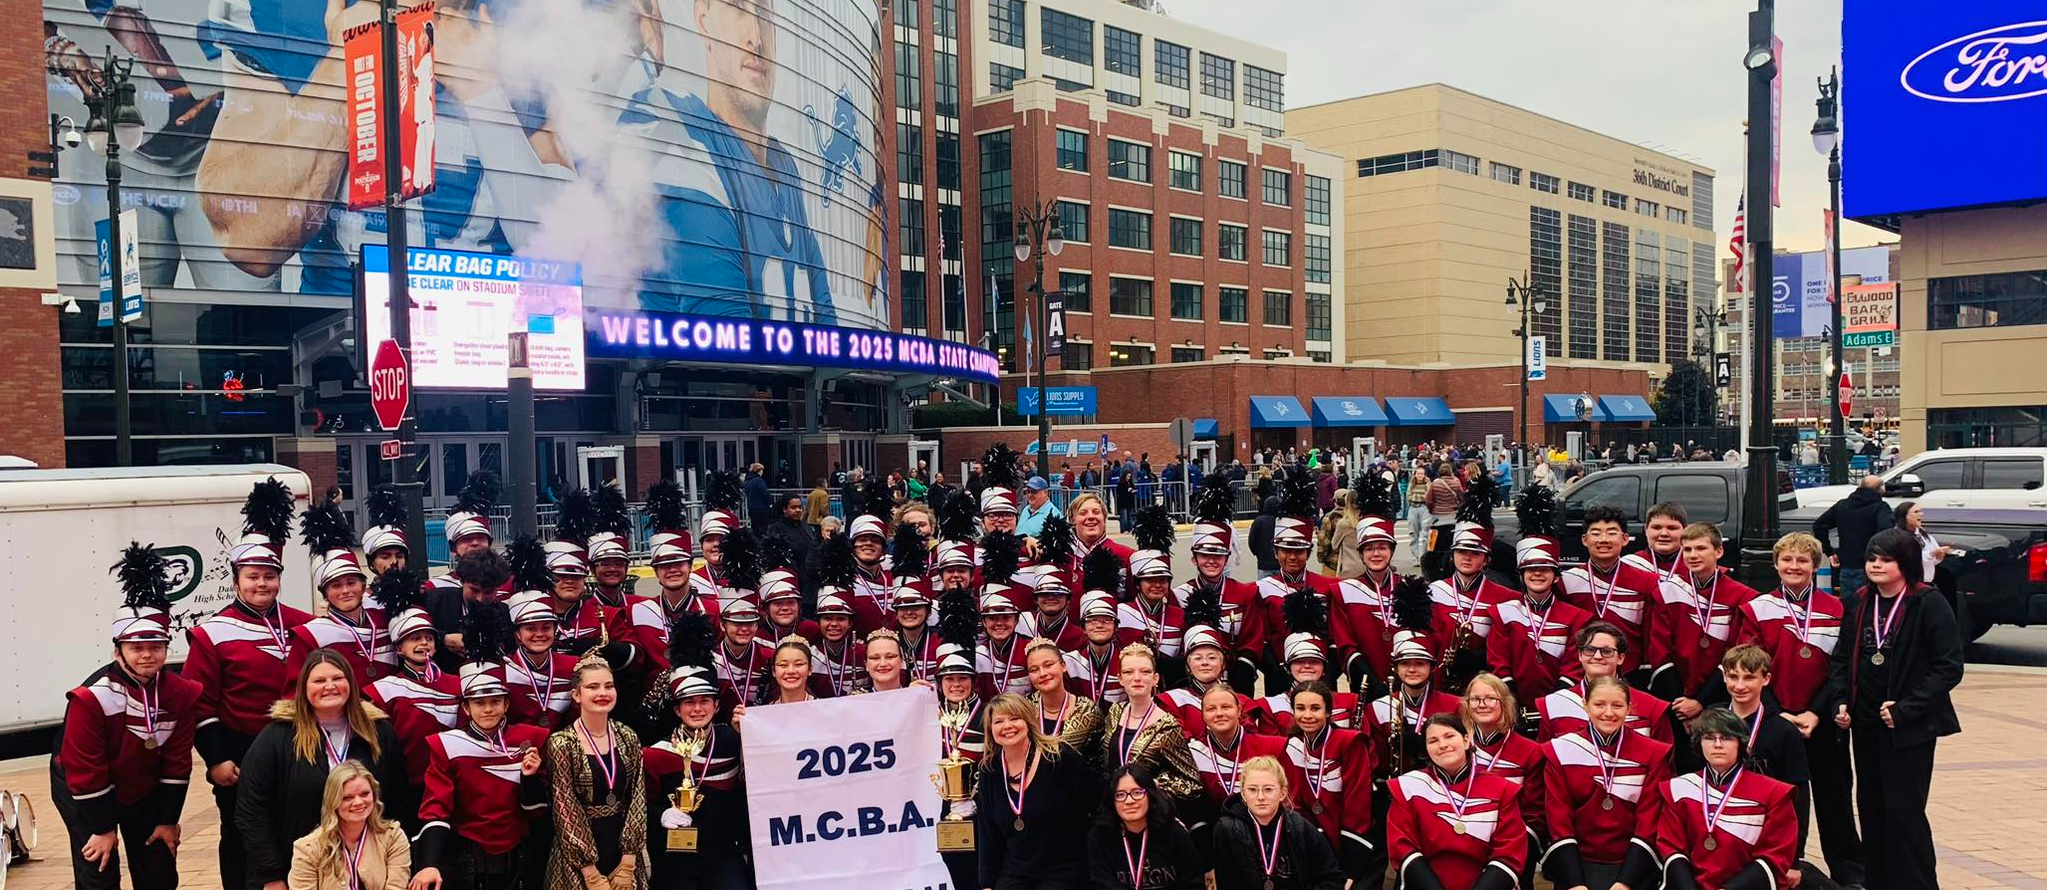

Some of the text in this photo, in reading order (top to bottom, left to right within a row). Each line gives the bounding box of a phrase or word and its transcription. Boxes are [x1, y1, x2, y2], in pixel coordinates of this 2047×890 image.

[1943, 31, 2047, 93] For
[354, 72, 377, 164] OCTOBER
[1632, 169, 1689, 197] 36th District Court
[408, 252, 560, 279] LEAR BAG POLICY
[420, 278, 454, 291] CLEAR
[456, 280, 470, 292] ON
[473, 281, 517, 295] STADIUM
[518, 283, 551, 298] SAFETY
[1846, 291, 1894, 304] ELWOOD
[1048, 301, 1063, 310] GATE
[1850, 304, 1879, 316] BAR
[1049, 311, 1064, 337] A
[601, 315, 751, 351] WELCOME
[762, 325, 795, 353] TO
[803, 329, 841, 357] THE
[849, 333, 893, 362] 2025
[899, 338, 936, 366] MCBA
[938, 344, 968, 371] STATE
[1846, 332, 1892, 347] Adams E
[1533, 339, 1541, 367] LIONS
[1718, 363, 1730, 378] A
[374, 366, 405, 402] STOP
[635, 379, 645, 392] A
[1046, 391, 1085, 401] LIONS SUPPLY
[1052, 444, 1068, 452] GATE
[1066, 439, 1078, 458] A
[194, 592, 237, 604] High Scho
[796, 738, 897, 780] 2025
[768, 799, 935, 847] M.C.B.A.
